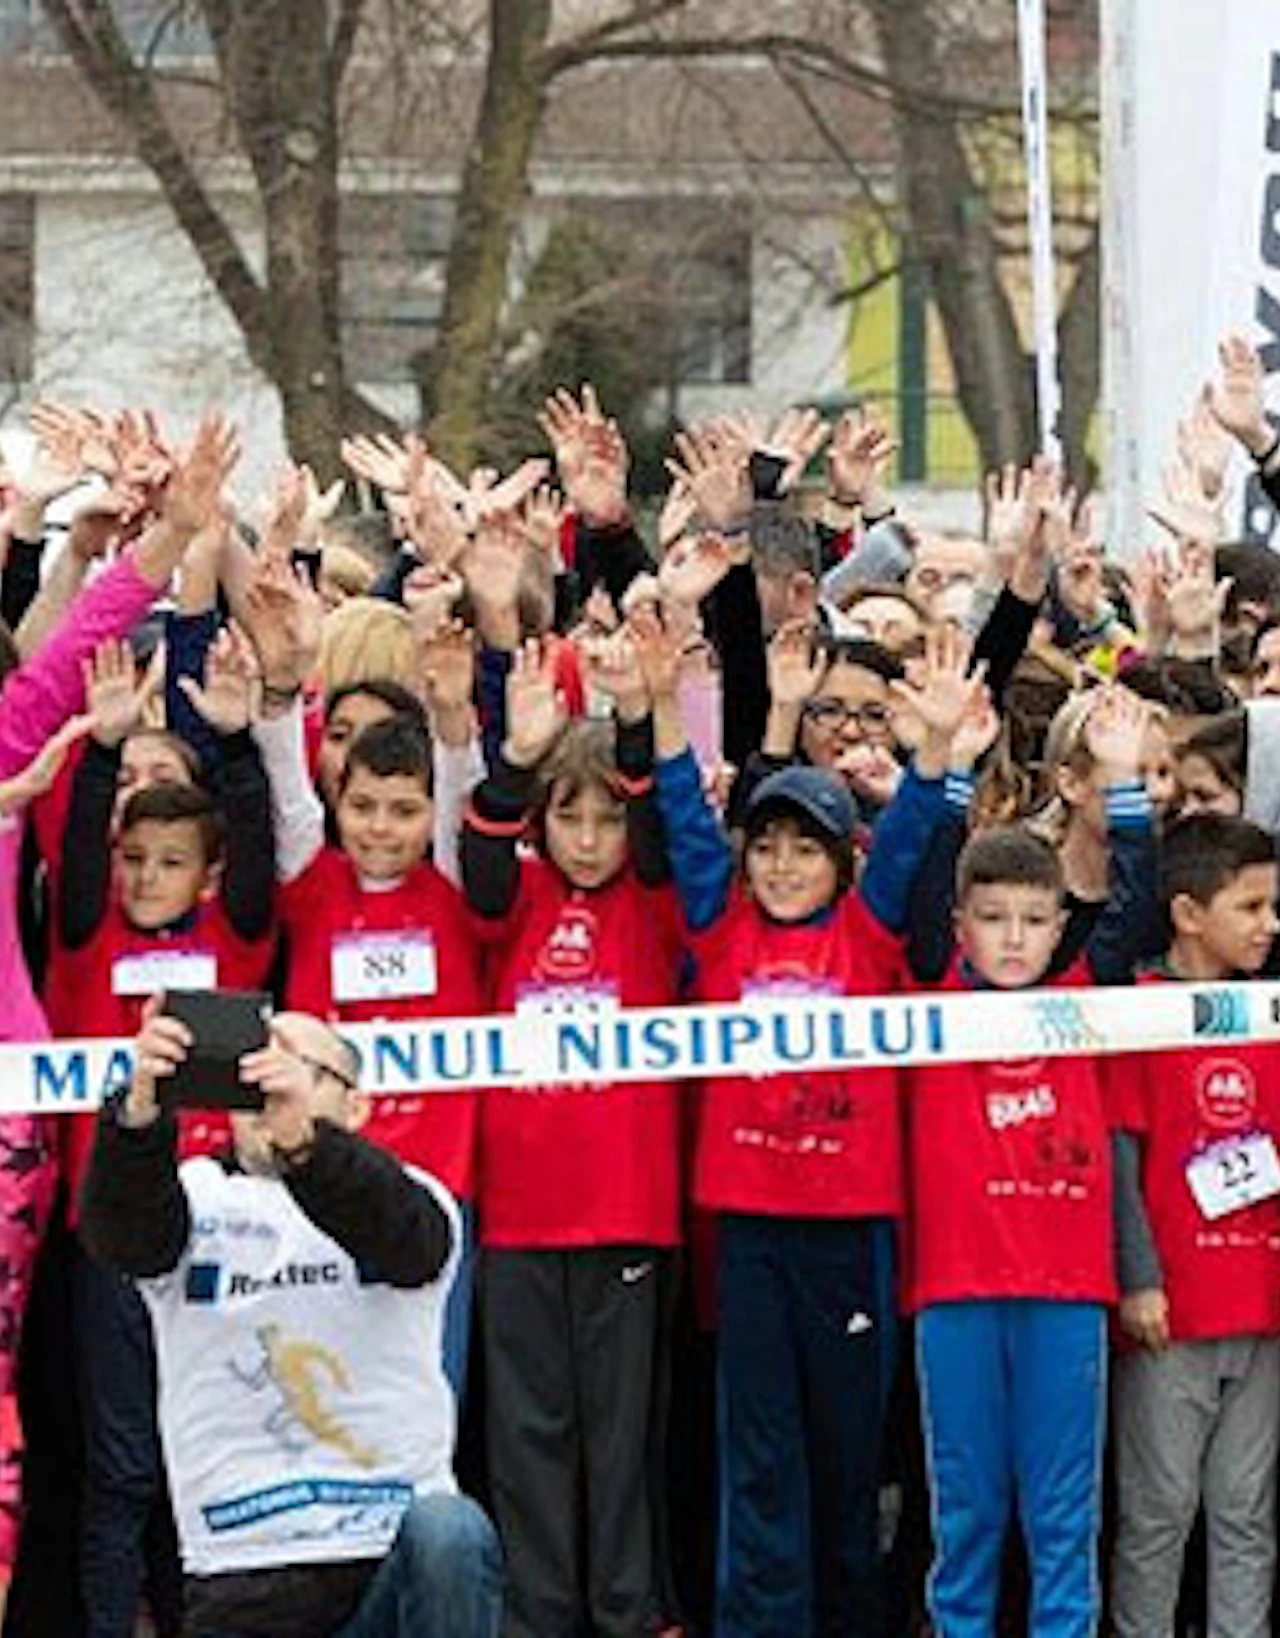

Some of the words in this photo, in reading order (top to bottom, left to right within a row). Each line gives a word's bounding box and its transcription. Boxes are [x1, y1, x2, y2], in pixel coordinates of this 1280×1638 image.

[363, 950, 407, 980] 88
[557, 1003, 945, 1073] NISIPULUI
[1220, 1151, 1257, 1189] 22
